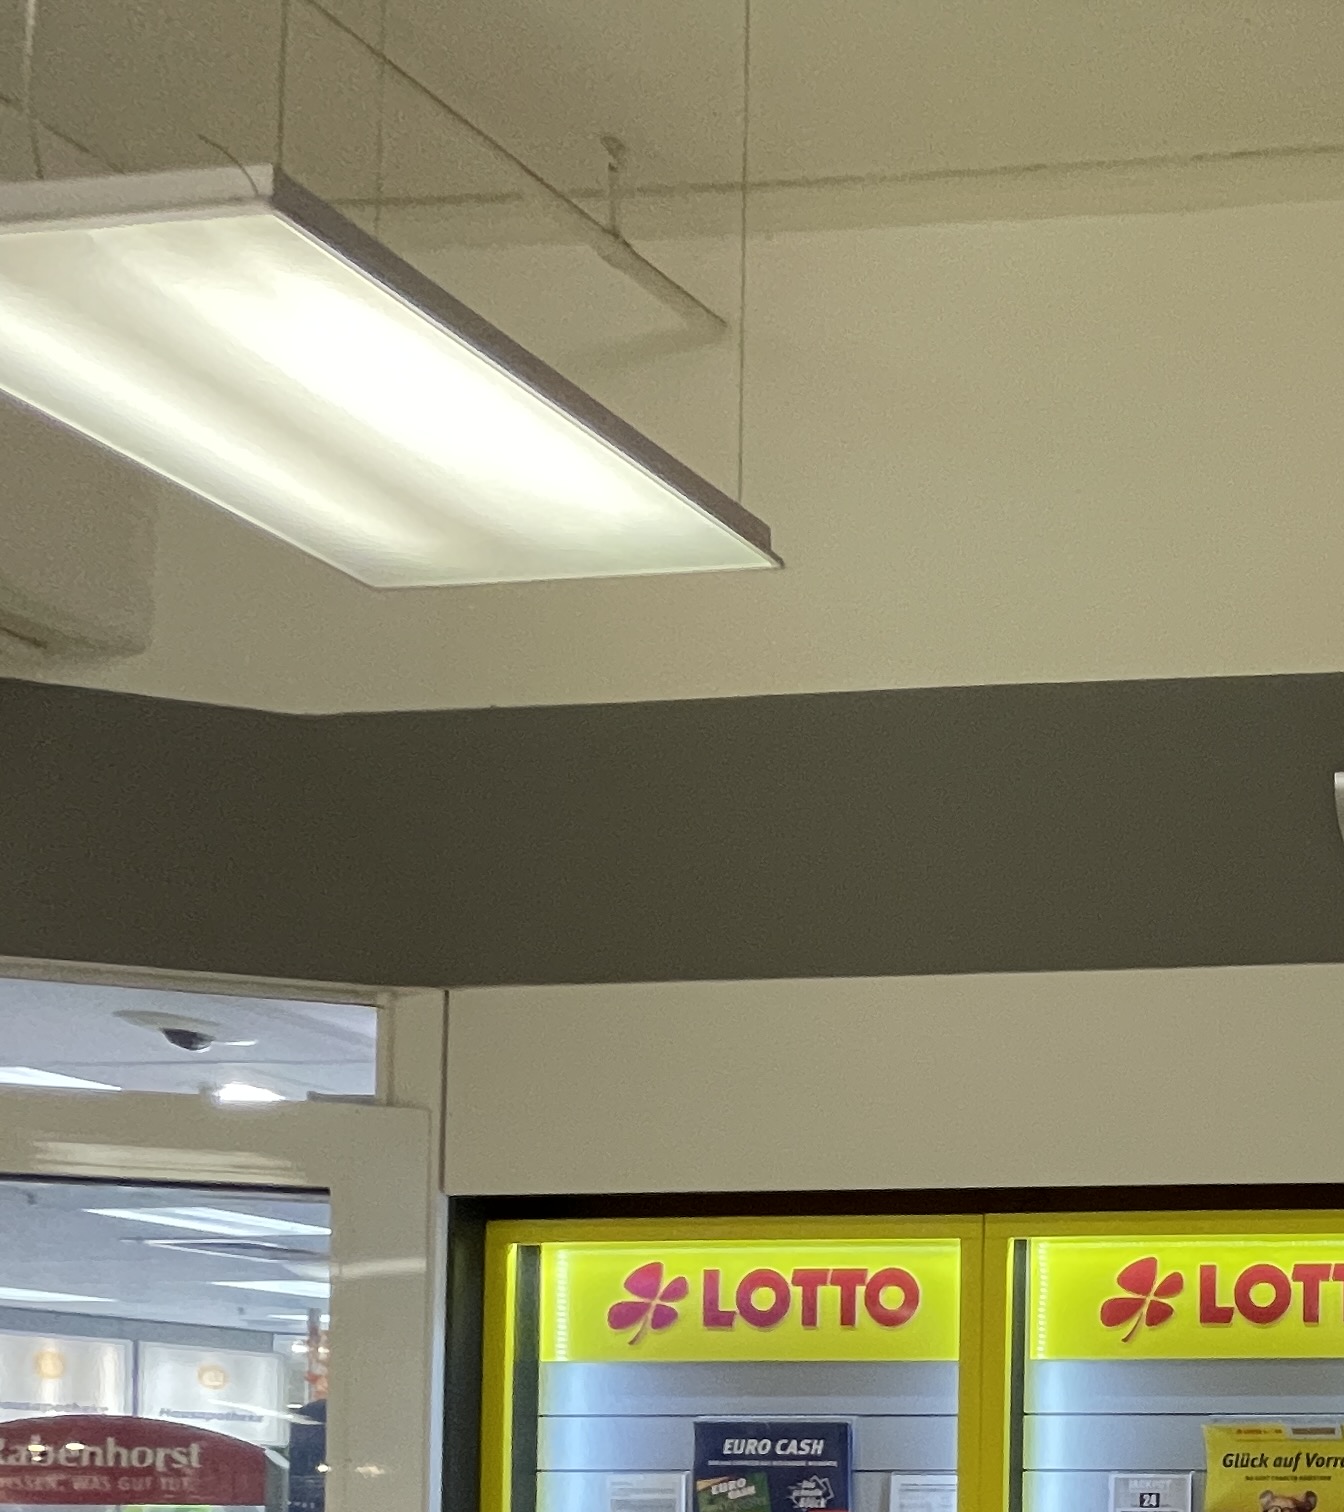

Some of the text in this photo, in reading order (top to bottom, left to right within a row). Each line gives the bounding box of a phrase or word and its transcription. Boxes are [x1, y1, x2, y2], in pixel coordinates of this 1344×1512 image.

[702, 1266, 921, 1328] LOTTO
[723, 1438, 824, 1455] EURO CASH
[1222, 1453, 1269, 1468] Glück
[1273, 1453, 1302, 1472] auf
[1142, 1494, 1157, 1507] 24
